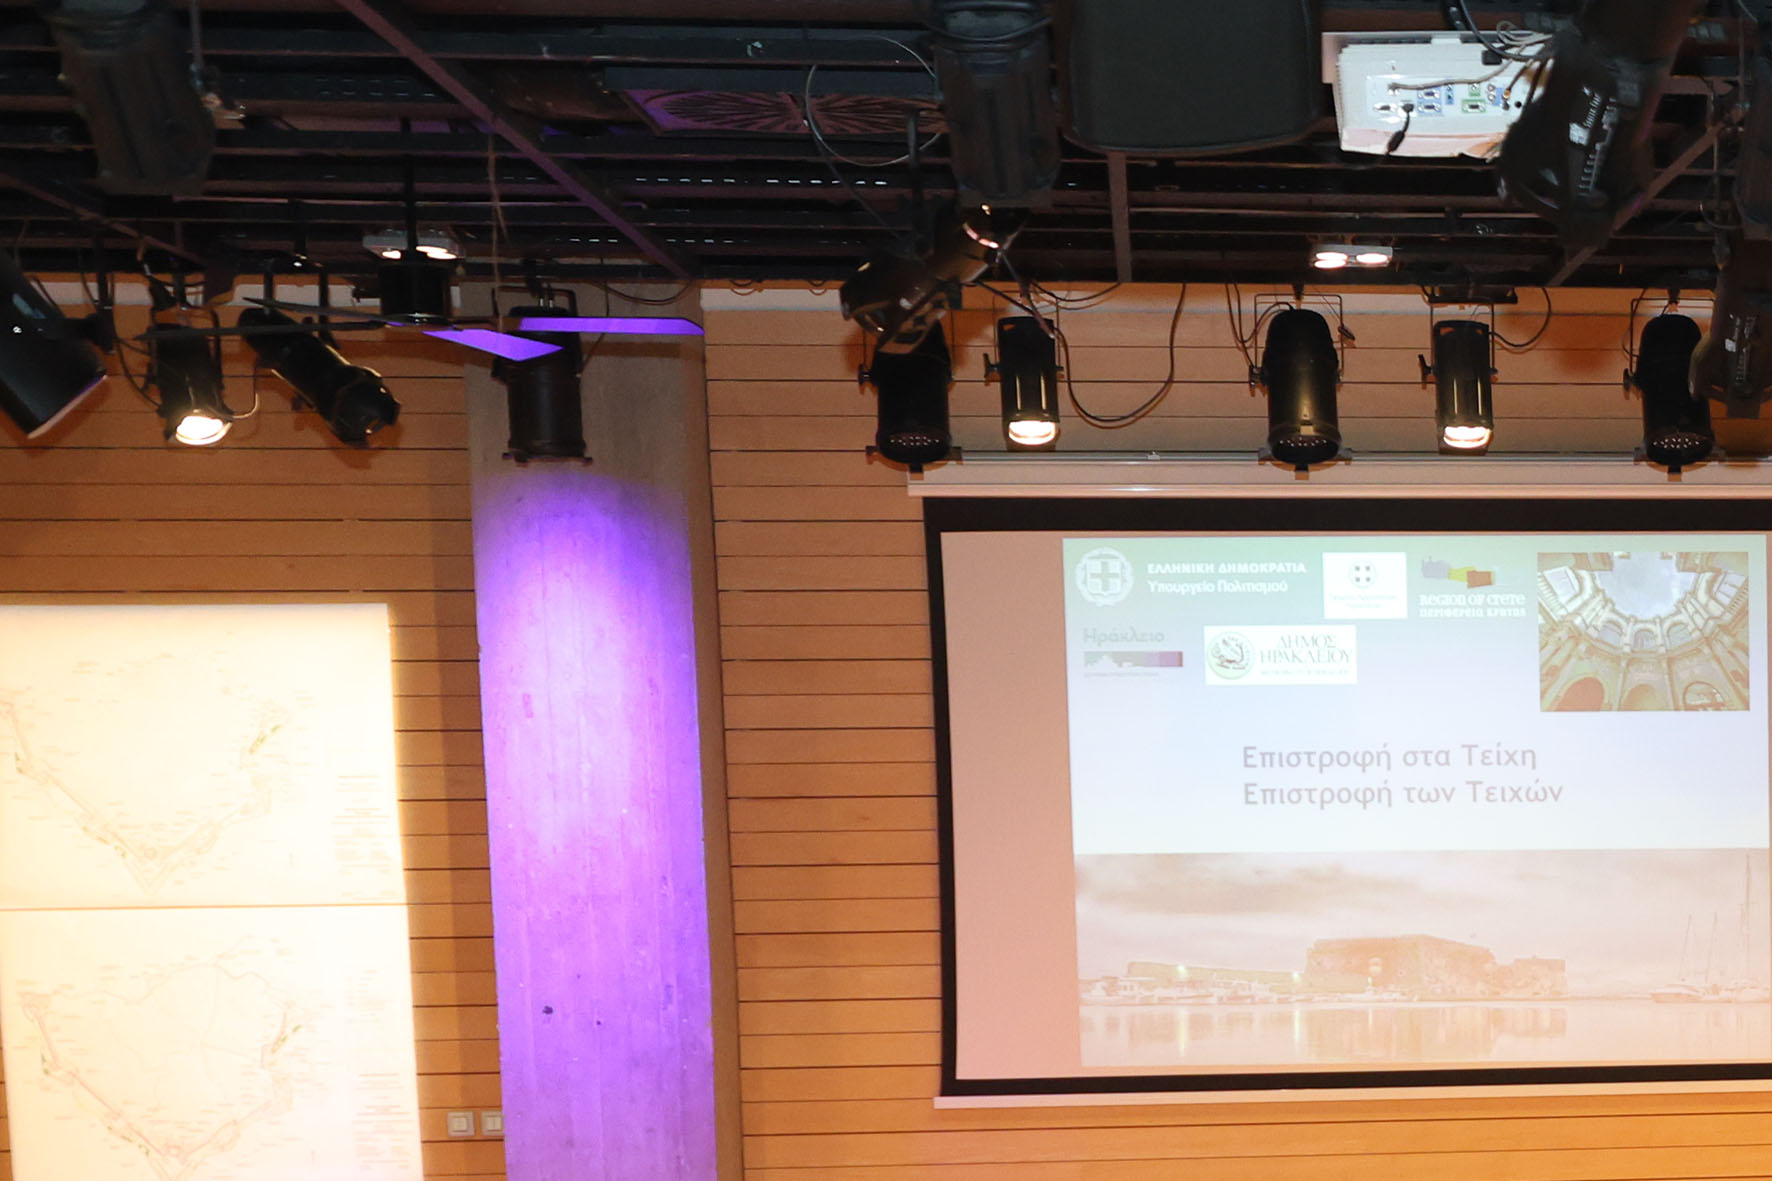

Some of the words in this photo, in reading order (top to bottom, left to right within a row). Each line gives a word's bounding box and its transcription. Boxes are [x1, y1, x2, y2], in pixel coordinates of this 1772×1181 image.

[1147, 562, 1215, 574] ΕΛΛΗΝΙΚΗ
[1218, 562, 1307, 574] ΔΗΜΟΚΡΑΤΙΑ
[1148, 579, 1215, 595] Υπουργείο
[1217, 579, 1288, 595] Πολιτισμού
[1083, 625, 1166, 647] Ηράκλειο
[1278, 633, 1337, 649] ΔΗΜΟΣ
[1243, 743, 1392, 773] Επιστροφή
[1402, 749, 1451, 767] στα
[1461, 742, 1538, 771] Τείχη
[1243, 780, 1393, 810] Επιστροφή
[1403, 785, 1456, 803] των
[1465, 779, 1564, 803] Τειχών
